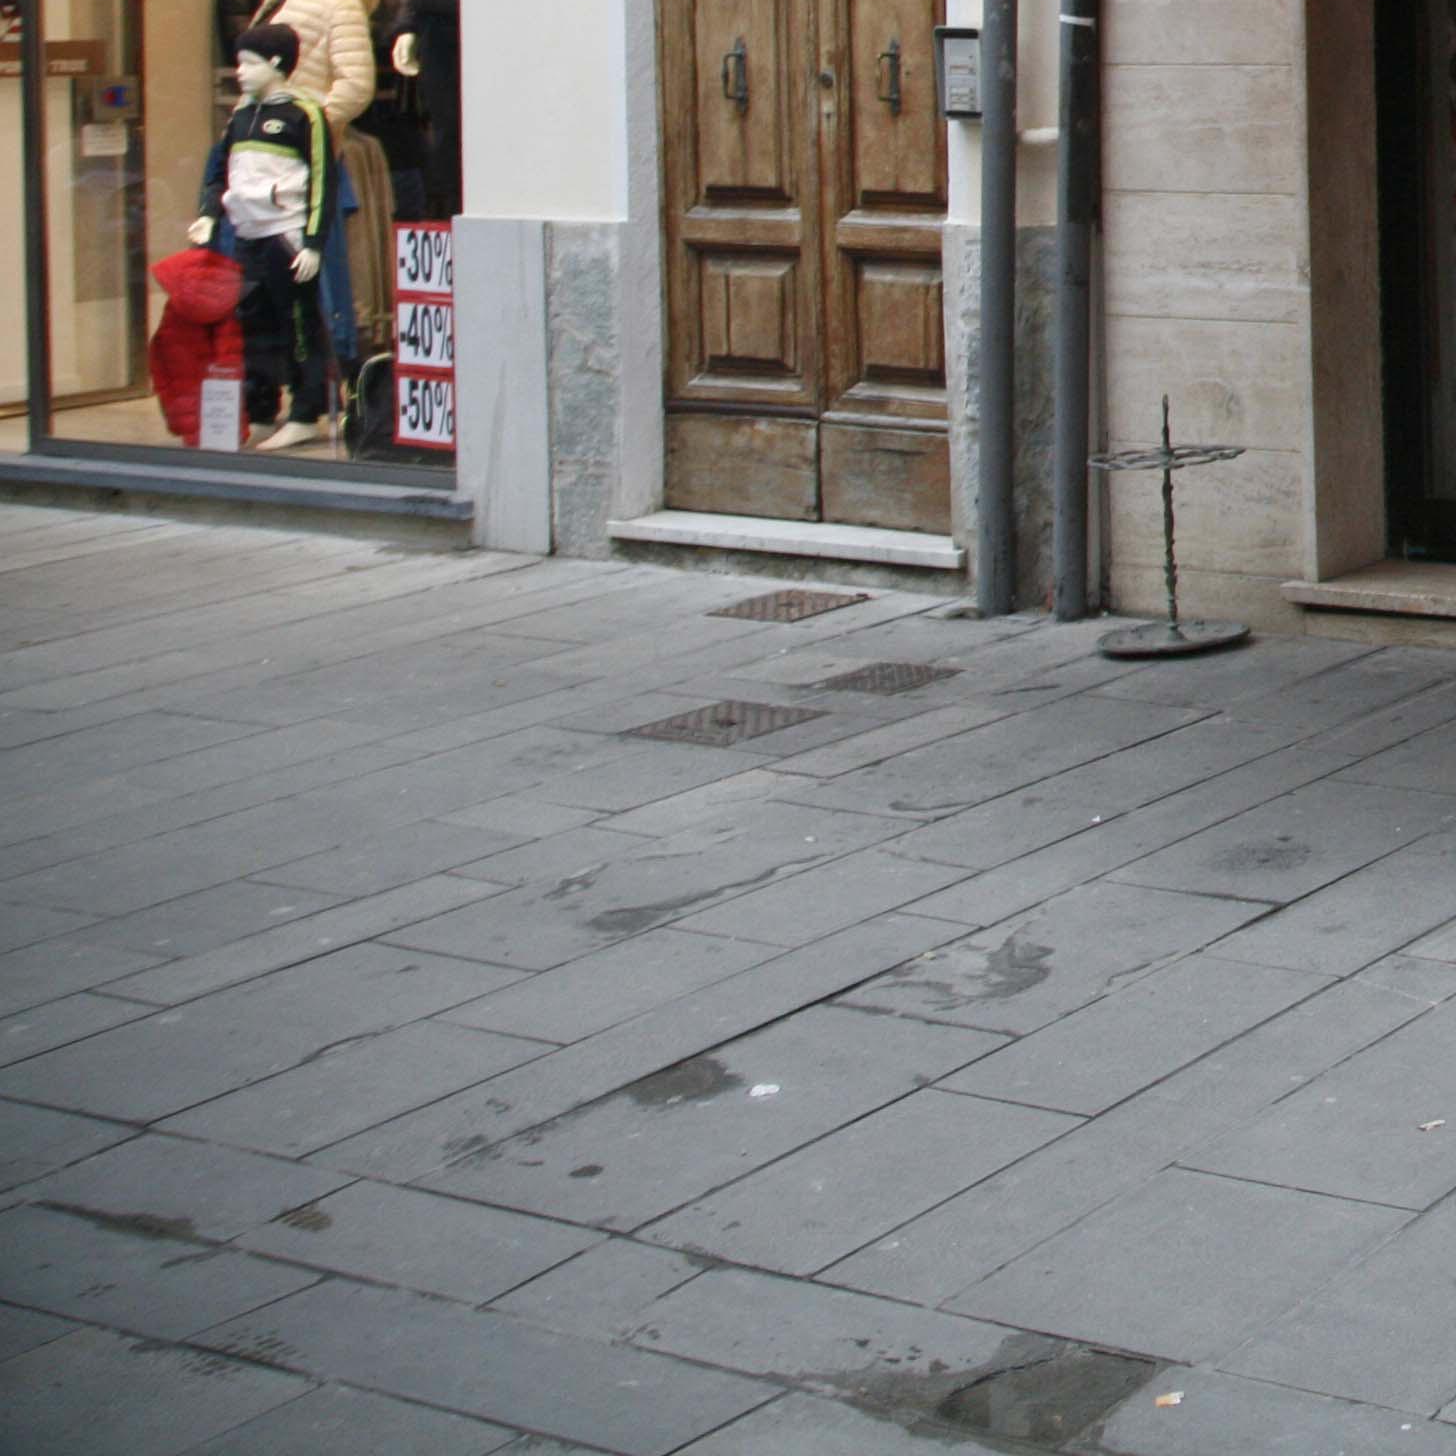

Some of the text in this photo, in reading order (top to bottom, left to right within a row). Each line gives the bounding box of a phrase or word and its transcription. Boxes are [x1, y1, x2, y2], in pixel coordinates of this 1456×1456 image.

[399, 230, 453, 287] -30%
[399, 304, 454, 362] -40%
[400, 378, 455, 436] -50%
